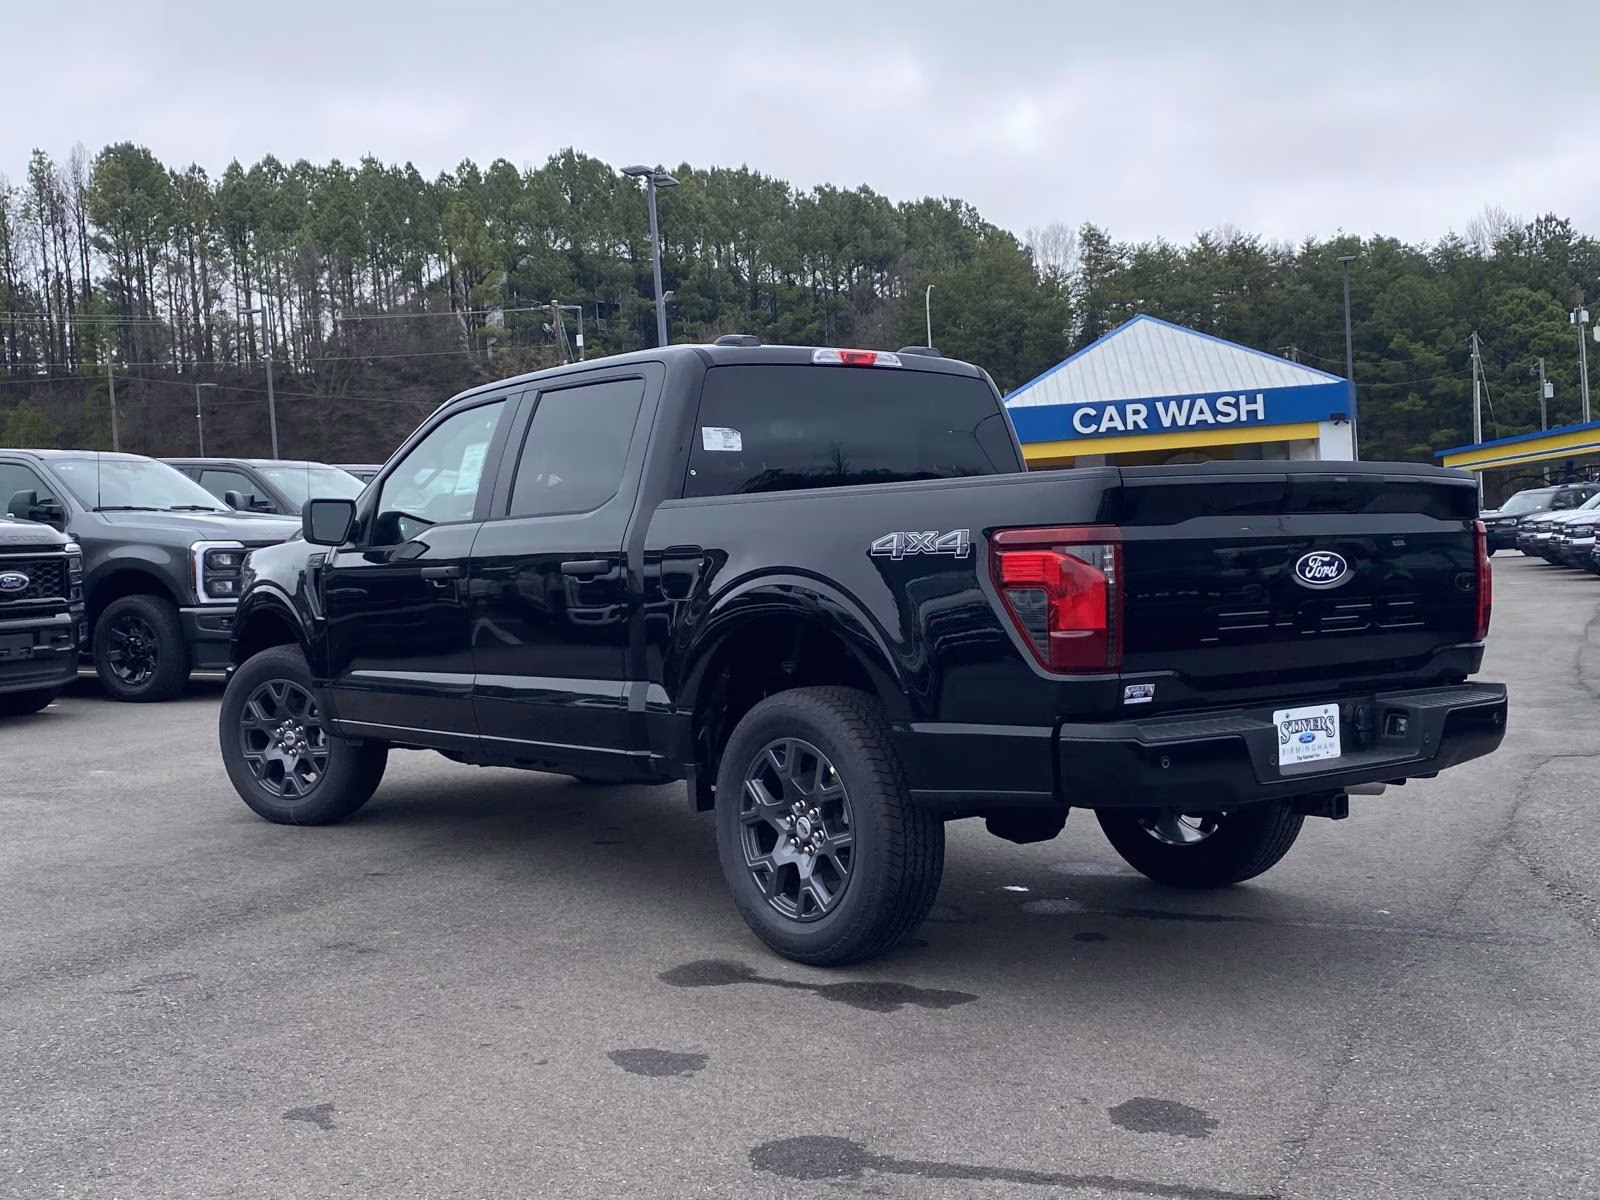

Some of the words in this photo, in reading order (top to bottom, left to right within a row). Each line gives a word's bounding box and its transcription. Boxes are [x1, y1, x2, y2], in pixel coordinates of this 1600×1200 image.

[1072, 403, 1149, 434] CAR
[1155, 393, 1265, 427] WASH
[1304, 555, 1339, 578] Ford
[1280, 715, 1335, 745] STIVERS
